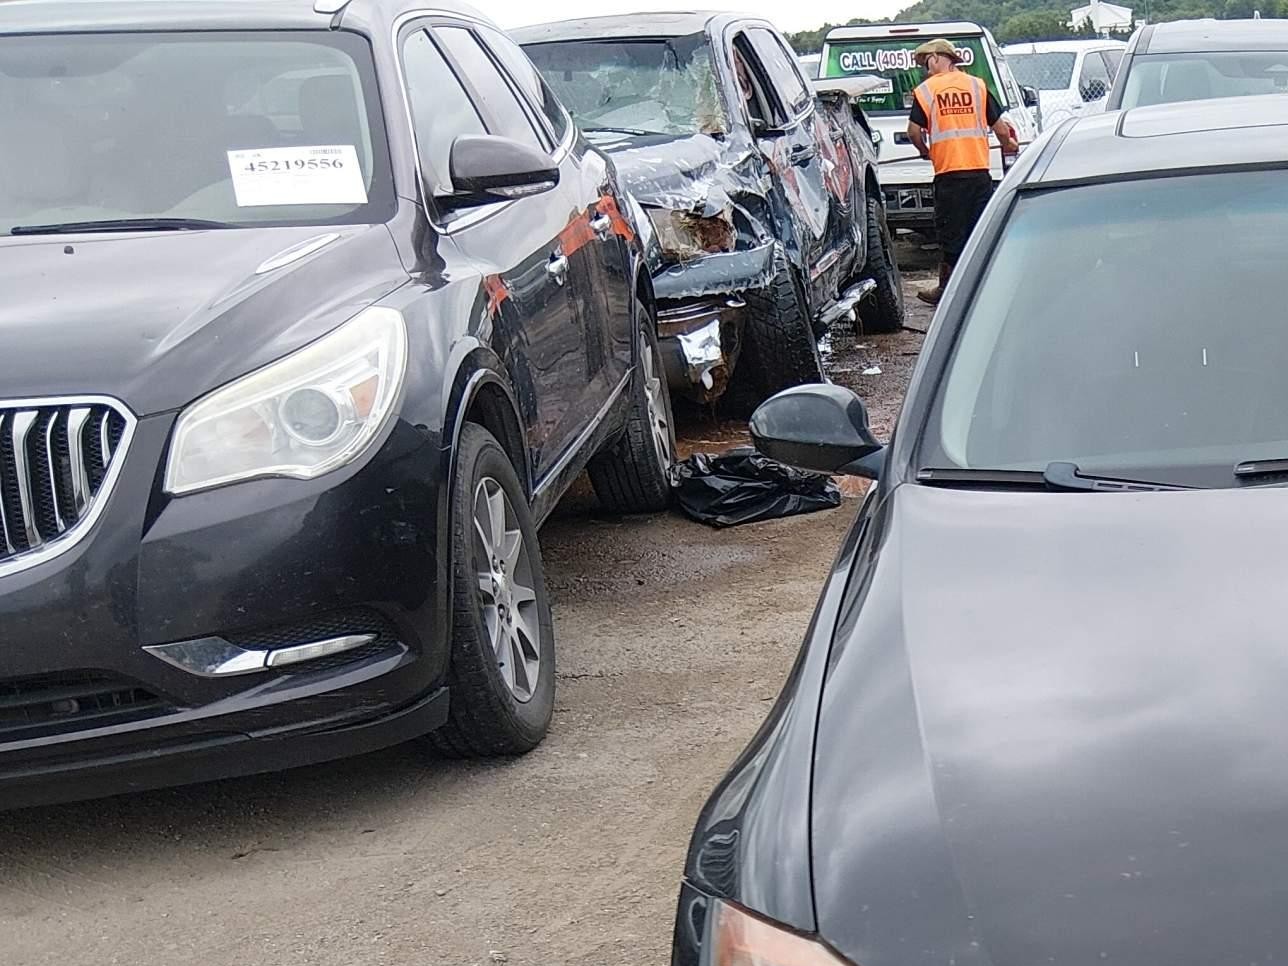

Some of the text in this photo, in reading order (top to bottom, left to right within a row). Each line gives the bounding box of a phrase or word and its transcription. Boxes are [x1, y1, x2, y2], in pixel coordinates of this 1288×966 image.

[840, 52, 876, 71] CALL
[876, 49, 909, 71] (405)
[936, 92, 973, 109] MAD
[244, 158, 344, 172] 45219556
